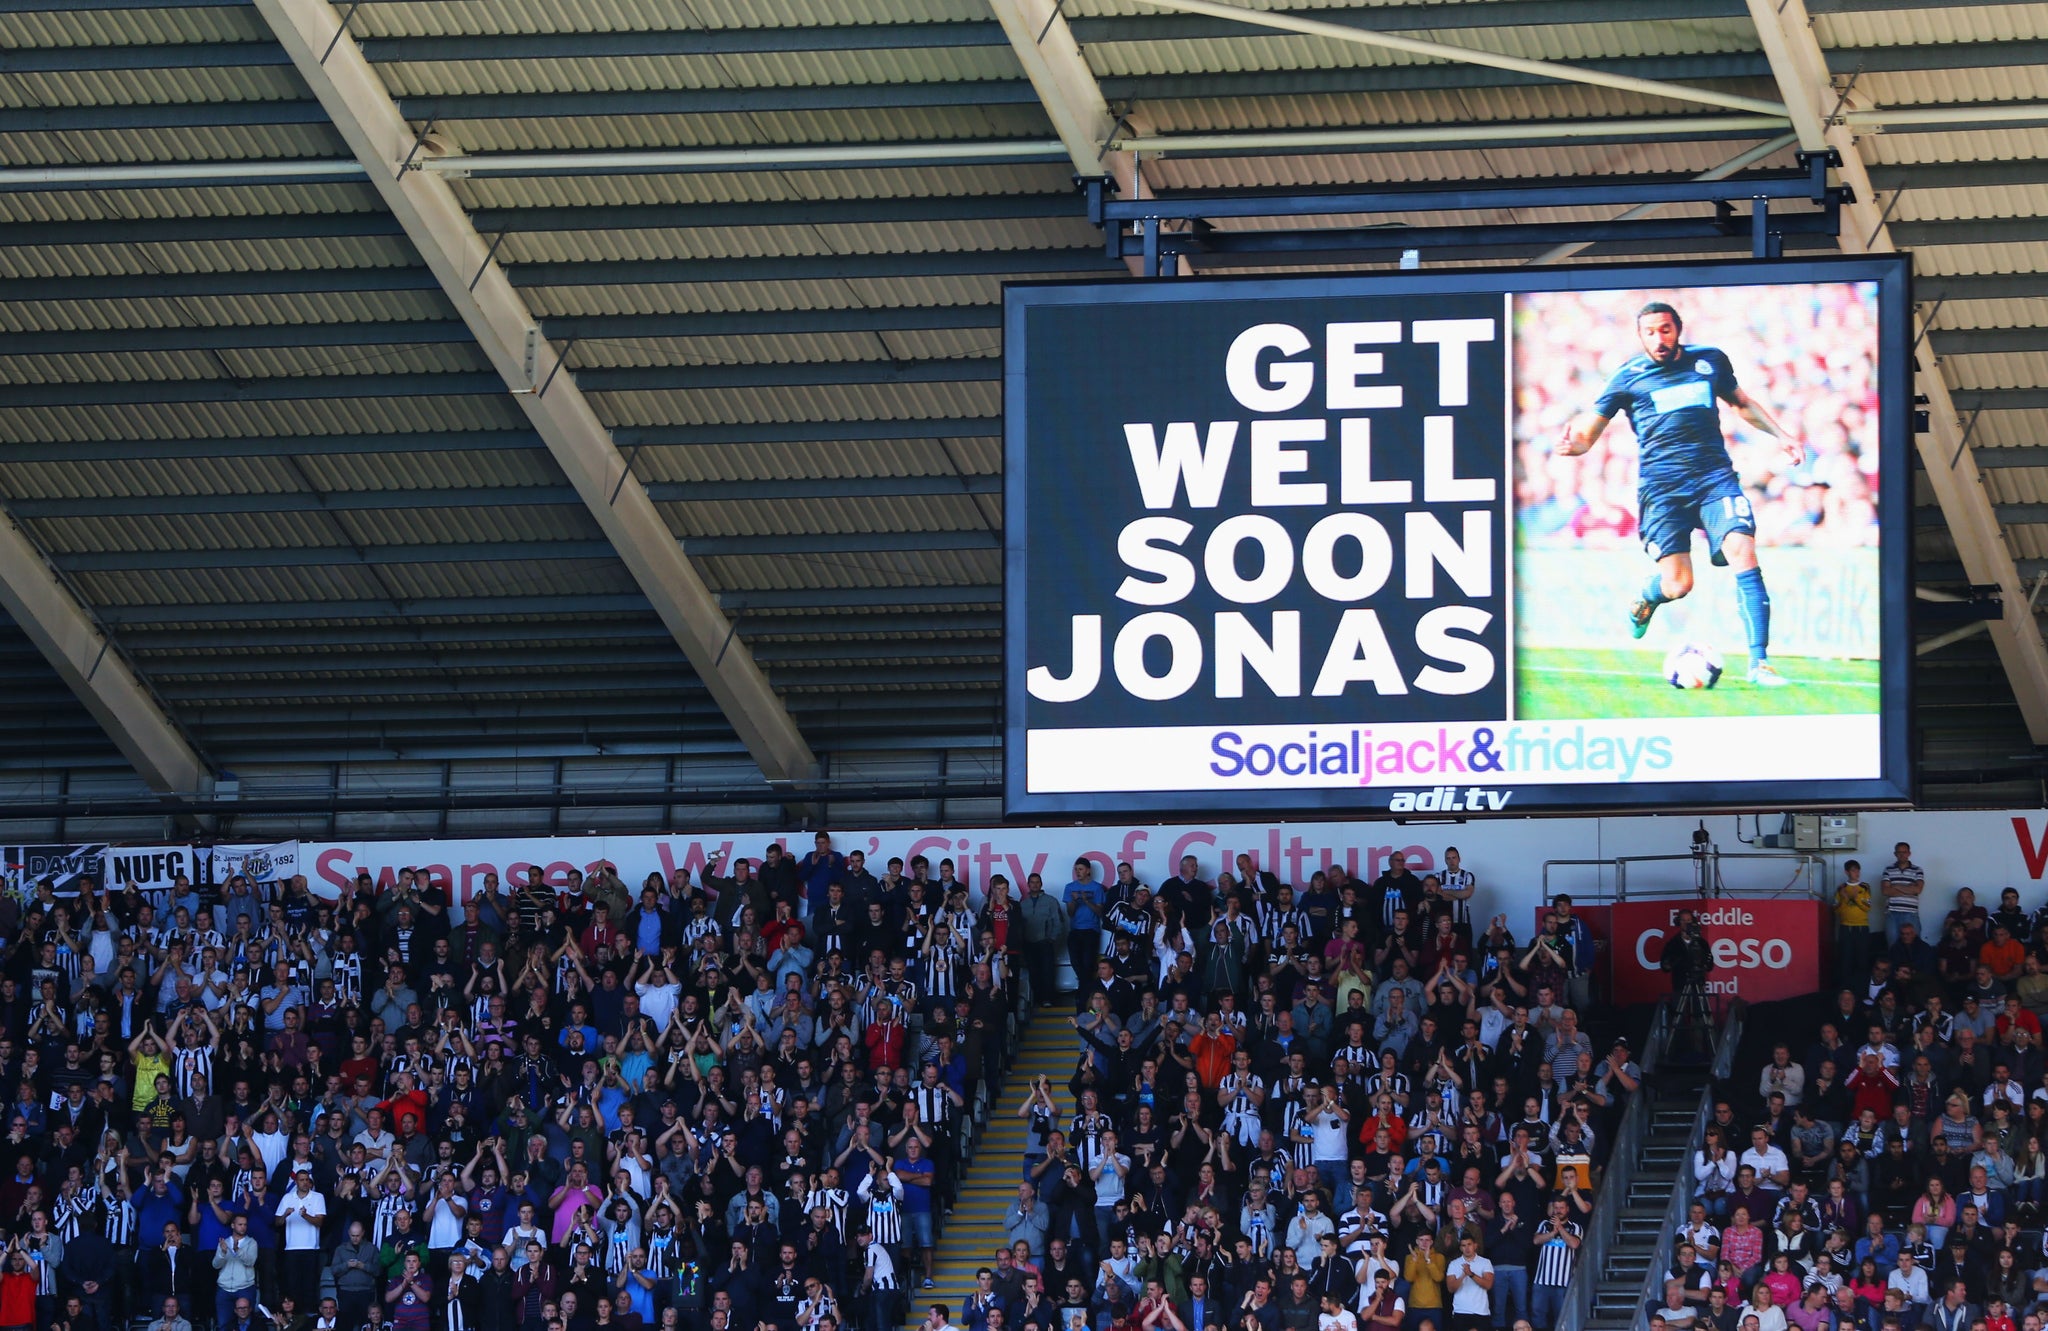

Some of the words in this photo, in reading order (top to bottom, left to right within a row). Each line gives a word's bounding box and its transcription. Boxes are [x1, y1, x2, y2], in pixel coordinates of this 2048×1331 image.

[1226, 318, 1495, 412] GET
[1123, 415, 1496, 508] WELL
[1115, 510, 1492, 605] SOON
[1027, 605, 1495, 702] JONAS
[1389, 786, 1513, 812] adi.tv
[30, 855, 98, 875] DAVE
[114, 851, 185, 884] NUFC
[274, 854, 294, 866] 1892
[905, 836, 1049, 901] City
[1635, 928, 1792, 970] Ceso
